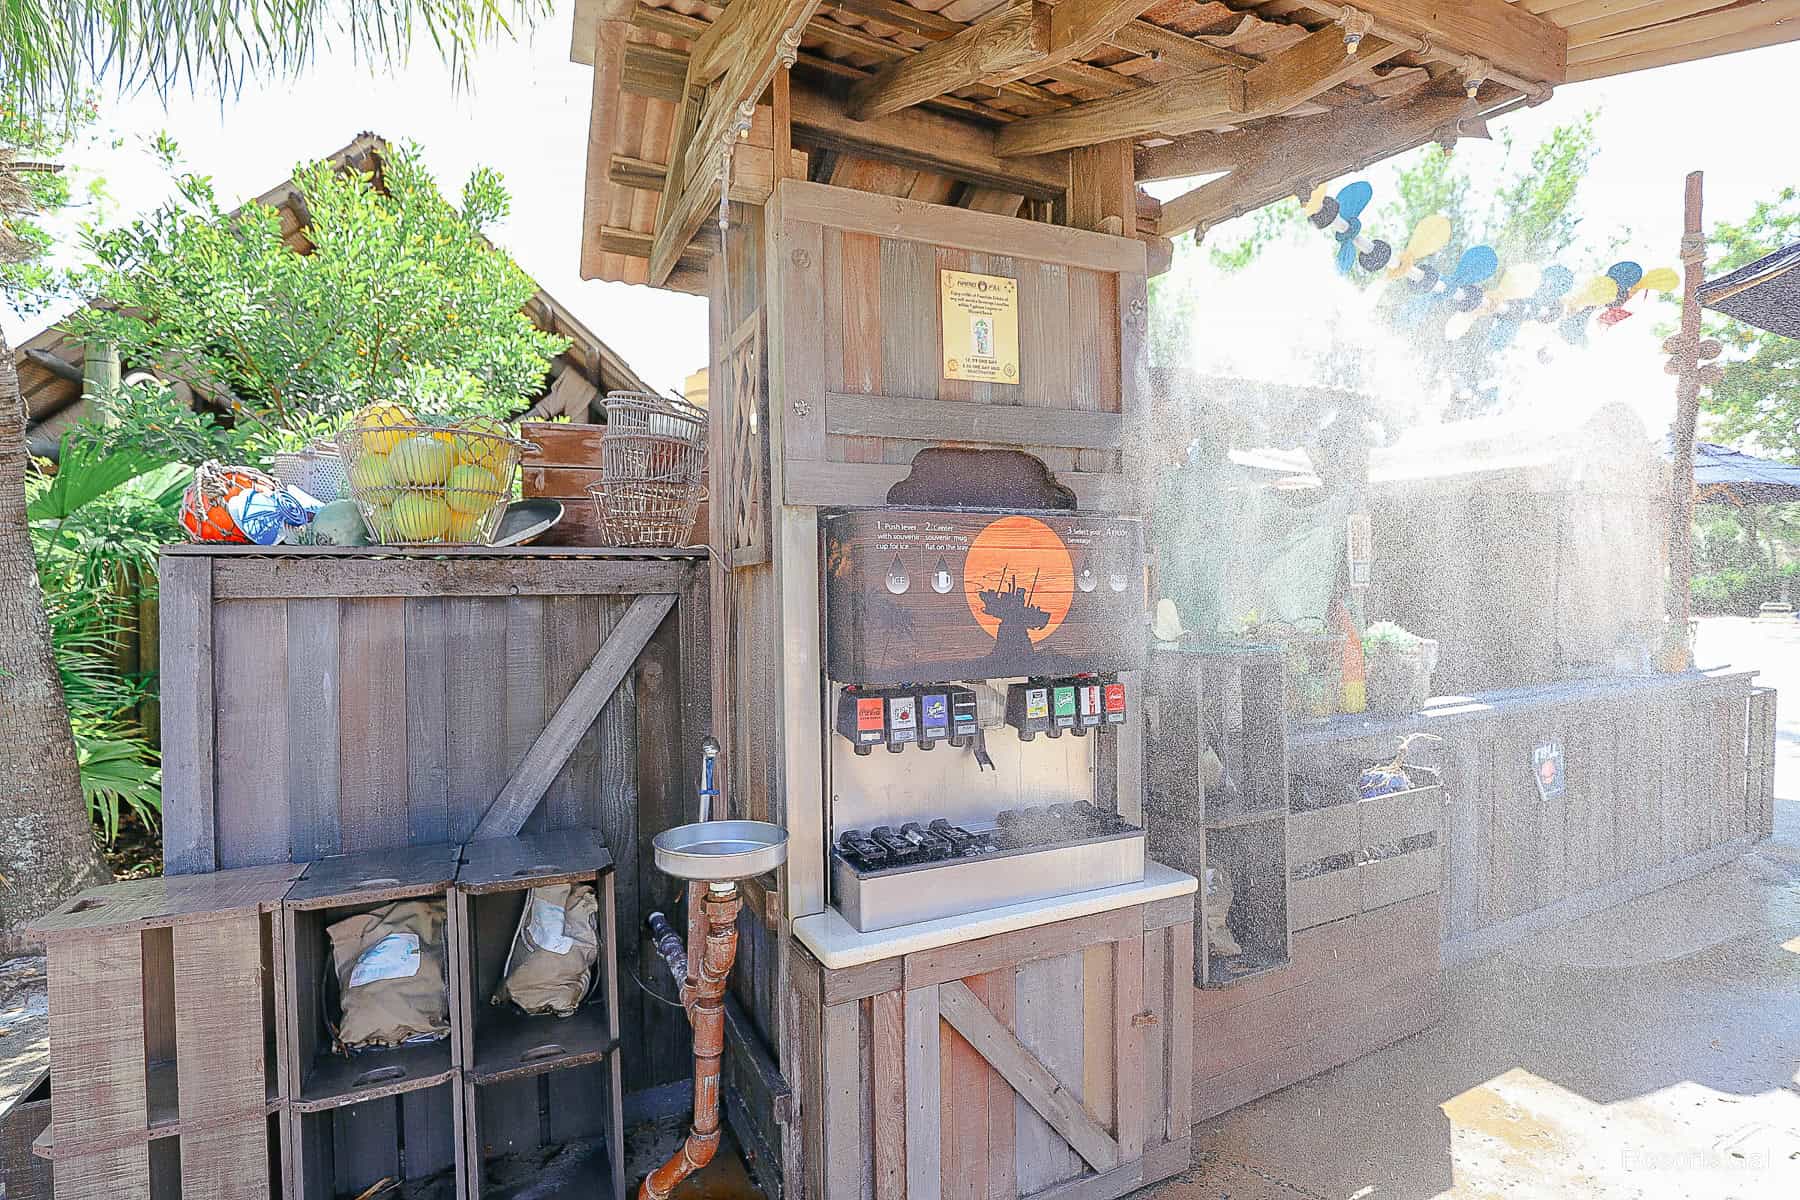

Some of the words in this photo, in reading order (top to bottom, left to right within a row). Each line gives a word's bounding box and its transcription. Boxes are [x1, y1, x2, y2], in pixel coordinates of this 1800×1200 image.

[901, 523, 917, 531] lever
[893, 533, 920, 541] souvenir
[953, 535, 968, 543] mug
[876, 543, 889, 551] cup
[956, 543, 969, 552] tray
[892, 576, 905, 585] ICE
